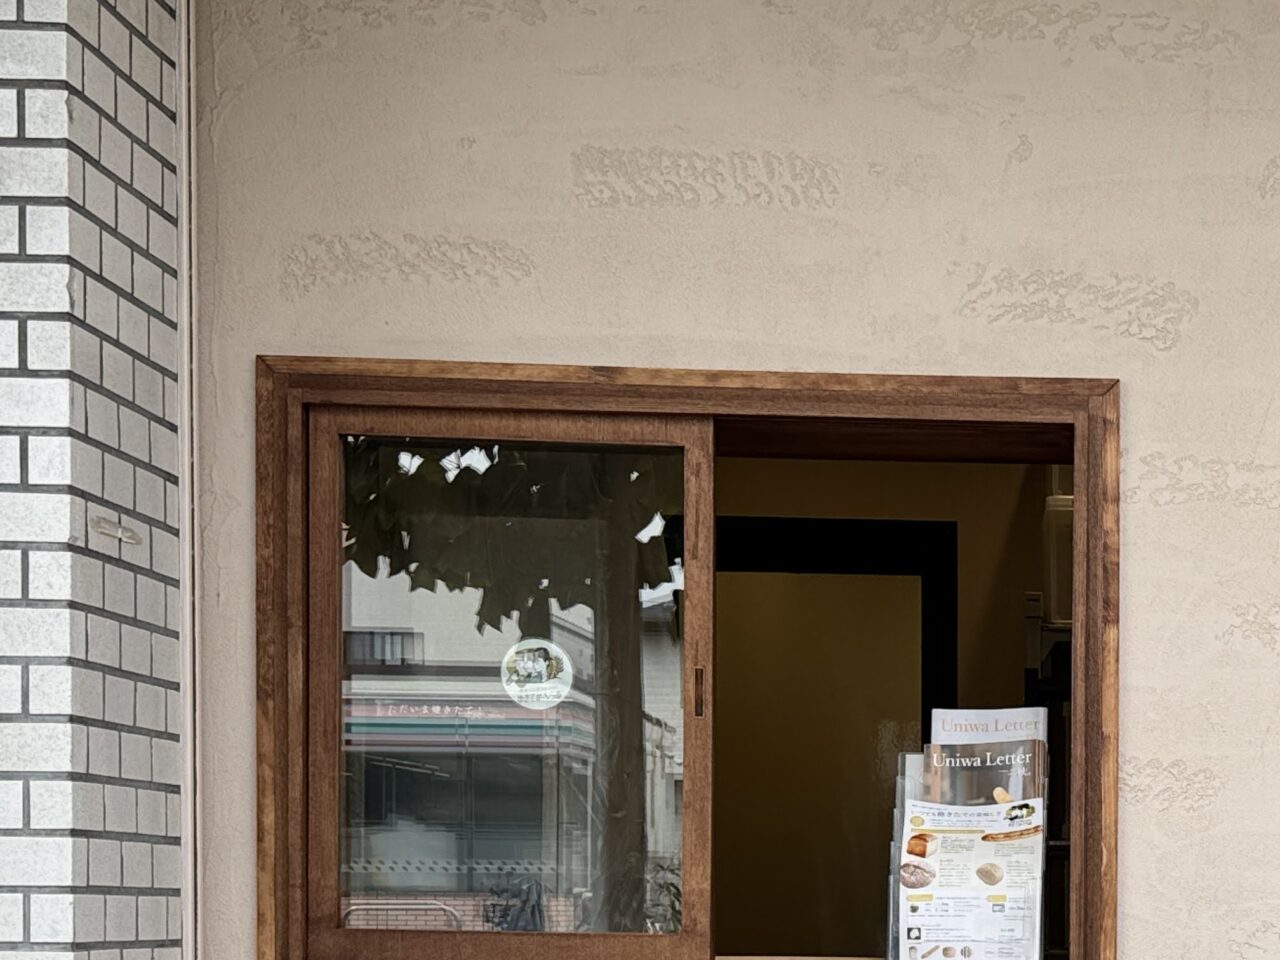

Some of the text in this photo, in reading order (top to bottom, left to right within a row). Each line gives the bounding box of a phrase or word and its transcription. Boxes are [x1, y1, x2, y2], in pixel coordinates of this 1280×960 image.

[942, 717, 1039, 733] Uniwa Letter
[932, 751, 1033, 767] Uniwa Letter
